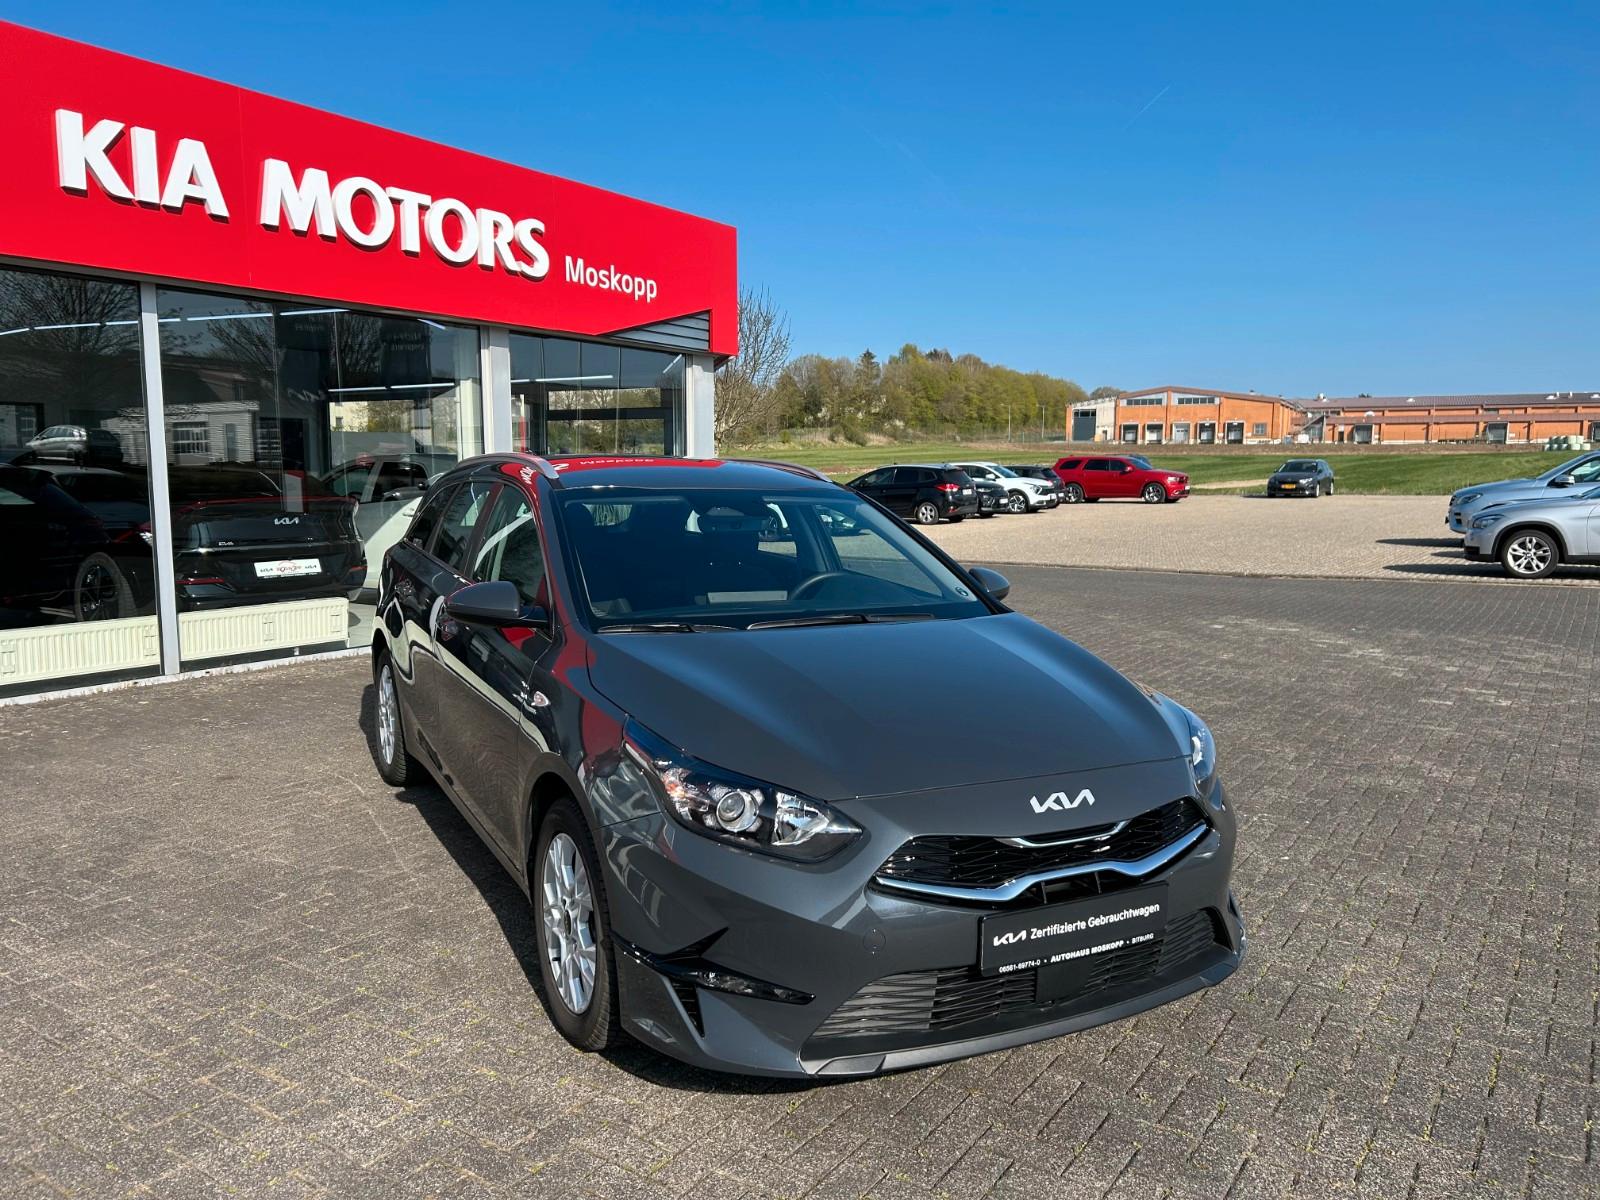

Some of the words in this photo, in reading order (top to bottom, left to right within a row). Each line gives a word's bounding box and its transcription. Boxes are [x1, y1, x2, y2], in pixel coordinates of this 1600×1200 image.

[55, 108, 230, 221] KIA
[259, 157, 550, 280] MOTORS
[564, 254, 658, 303] Moskopp
[274, 516, 300, 525] KIA
[1030, 788, 1096, 814] KIA
[993, 929, 1027, 947] KIA
[1030, 919, 1087, 940] Zertifizierte
[1087, 902, 1160, 928] Gebrauchtwagen
[1050, 947, 1090, 963] AUTOHAUS
[1090, 939, 1124, 955] MOSKOPP
[1131, 932, 1155, 945] BITBURG
